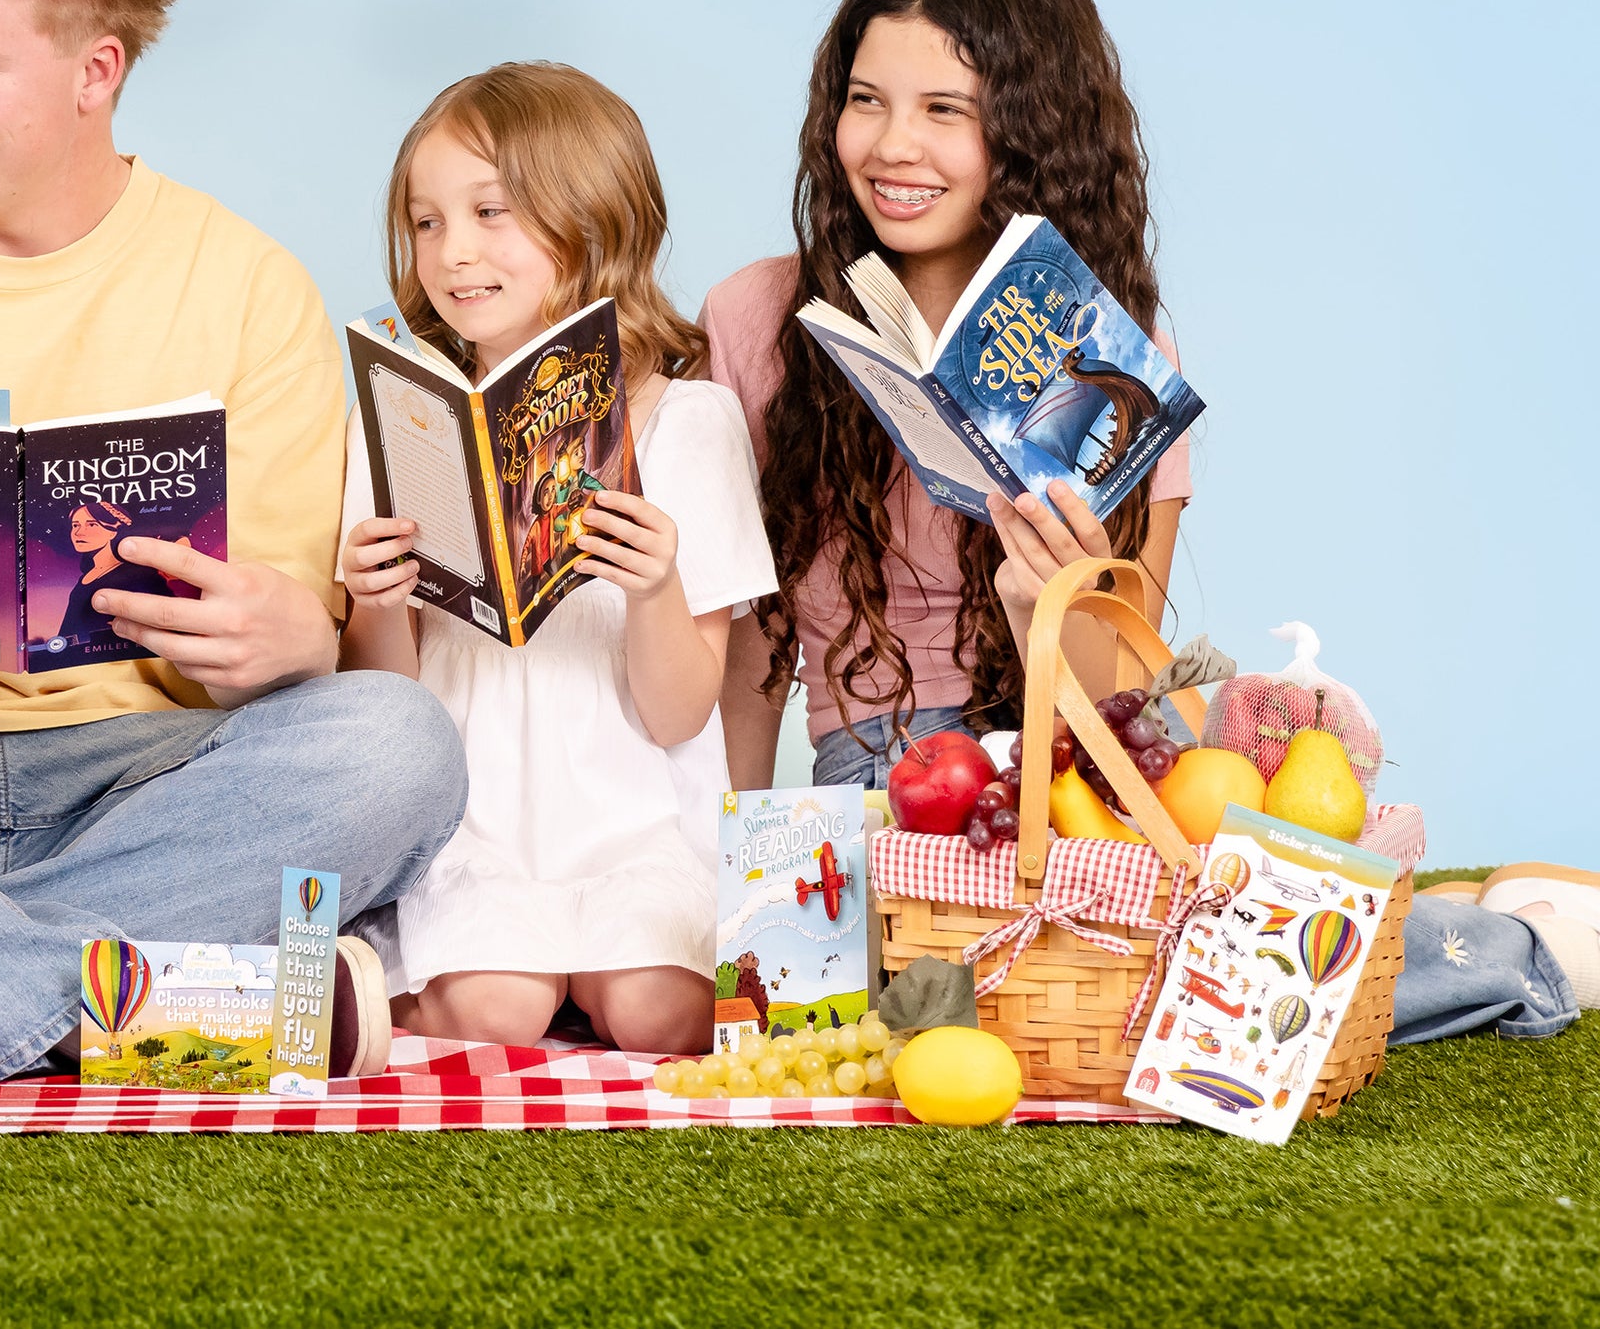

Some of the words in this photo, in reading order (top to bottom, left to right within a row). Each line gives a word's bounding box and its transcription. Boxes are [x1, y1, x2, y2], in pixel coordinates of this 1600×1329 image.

[1044, 288, 1057, 304] OF
[1047, 293, 1066, 314] THE
[979, 285, 1028, 333] FAR
[973, 298, 1051, 390] SIDE
[1011, 302, 1100, 402] SEA
[529, 371, 589, 424] SECRET
[522, 390, 591, 456] DOOR
[105, 438, 145, 454] THE
[42, 444, 208, 485] KINGDOM
[1101, 468, 1132, 502] REBECCA
[1130, 425, 1171, 469] BURNWORTH
[51, 486, 76, 499] OF
[79, 473, 196, 505] STARS
[84, 641, 129, 654] EMILEE
[744, 814, 790, 839] SUMMER
[738, 811, 846, 874] READING
[1267, 828, 1308, 851] Sticker
[1309, 843, 1343, 864] Sheet
[765, 850, 811, 877] PROGRAM
[286, 916, 330, 937] Choose
[738, 927, 760, 949] Choose
[760, 918, 781, 931] books
[781, 918, 797, 930] that
[797, 925, 815, 940] make
[815, 934, 830, 943] you
[830, 931, 840, 941] fly
[840, 913, 862, 936] higher!
[286, 934, 327, 957] books
[286, 956, 323, 979] that
[155, 991, 216, 1008] Choose
[220, 992, 270, 1010] books
[283, 978, 325, 998] make
[165, 1008, 199, 1023] that
[203, 1010, 242, 1024] make
[246, 1016, 273, 1027] you
[282, 994, 321, 1017] you
[199, 1023, 217, 1038] fly
[220, 1024, 264, 1040] higher!
[283, 1018, 316, 1052] fly
[276, 1044, 325, 1067] higher!
